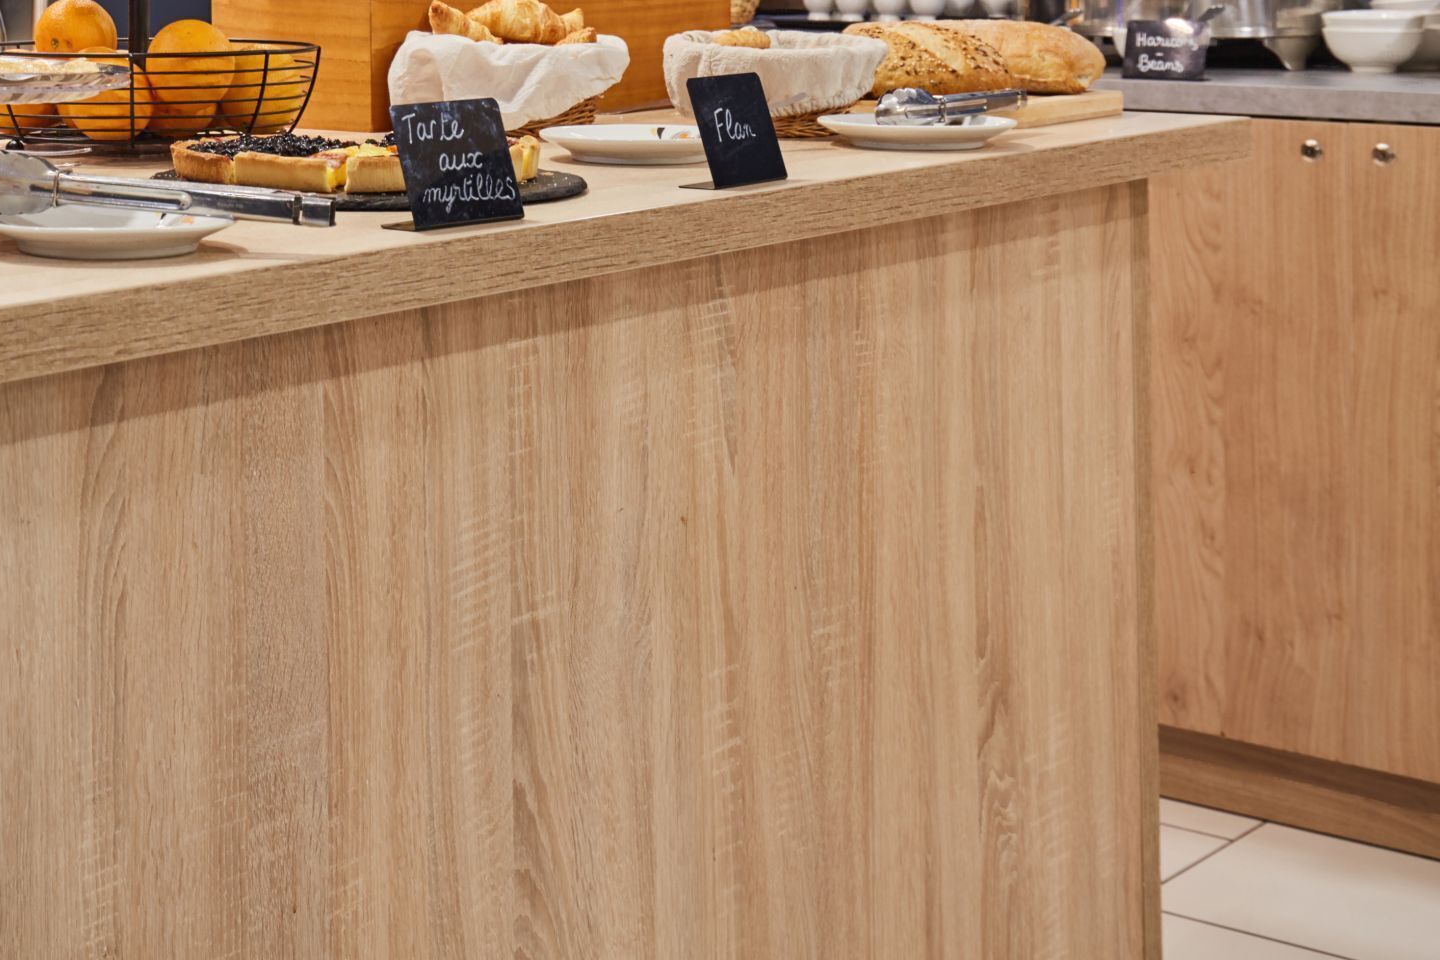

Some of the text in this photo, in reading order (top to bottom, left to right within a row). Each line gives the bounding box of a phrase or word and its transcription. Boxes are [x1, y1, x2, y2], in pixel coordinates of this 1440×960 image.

[401, 111, 465, 145] Tarte
[713, 107, 756, 143] Flan
[439, 151, 483, 171] aux
[422, 173, 516, 214] myrtilles
